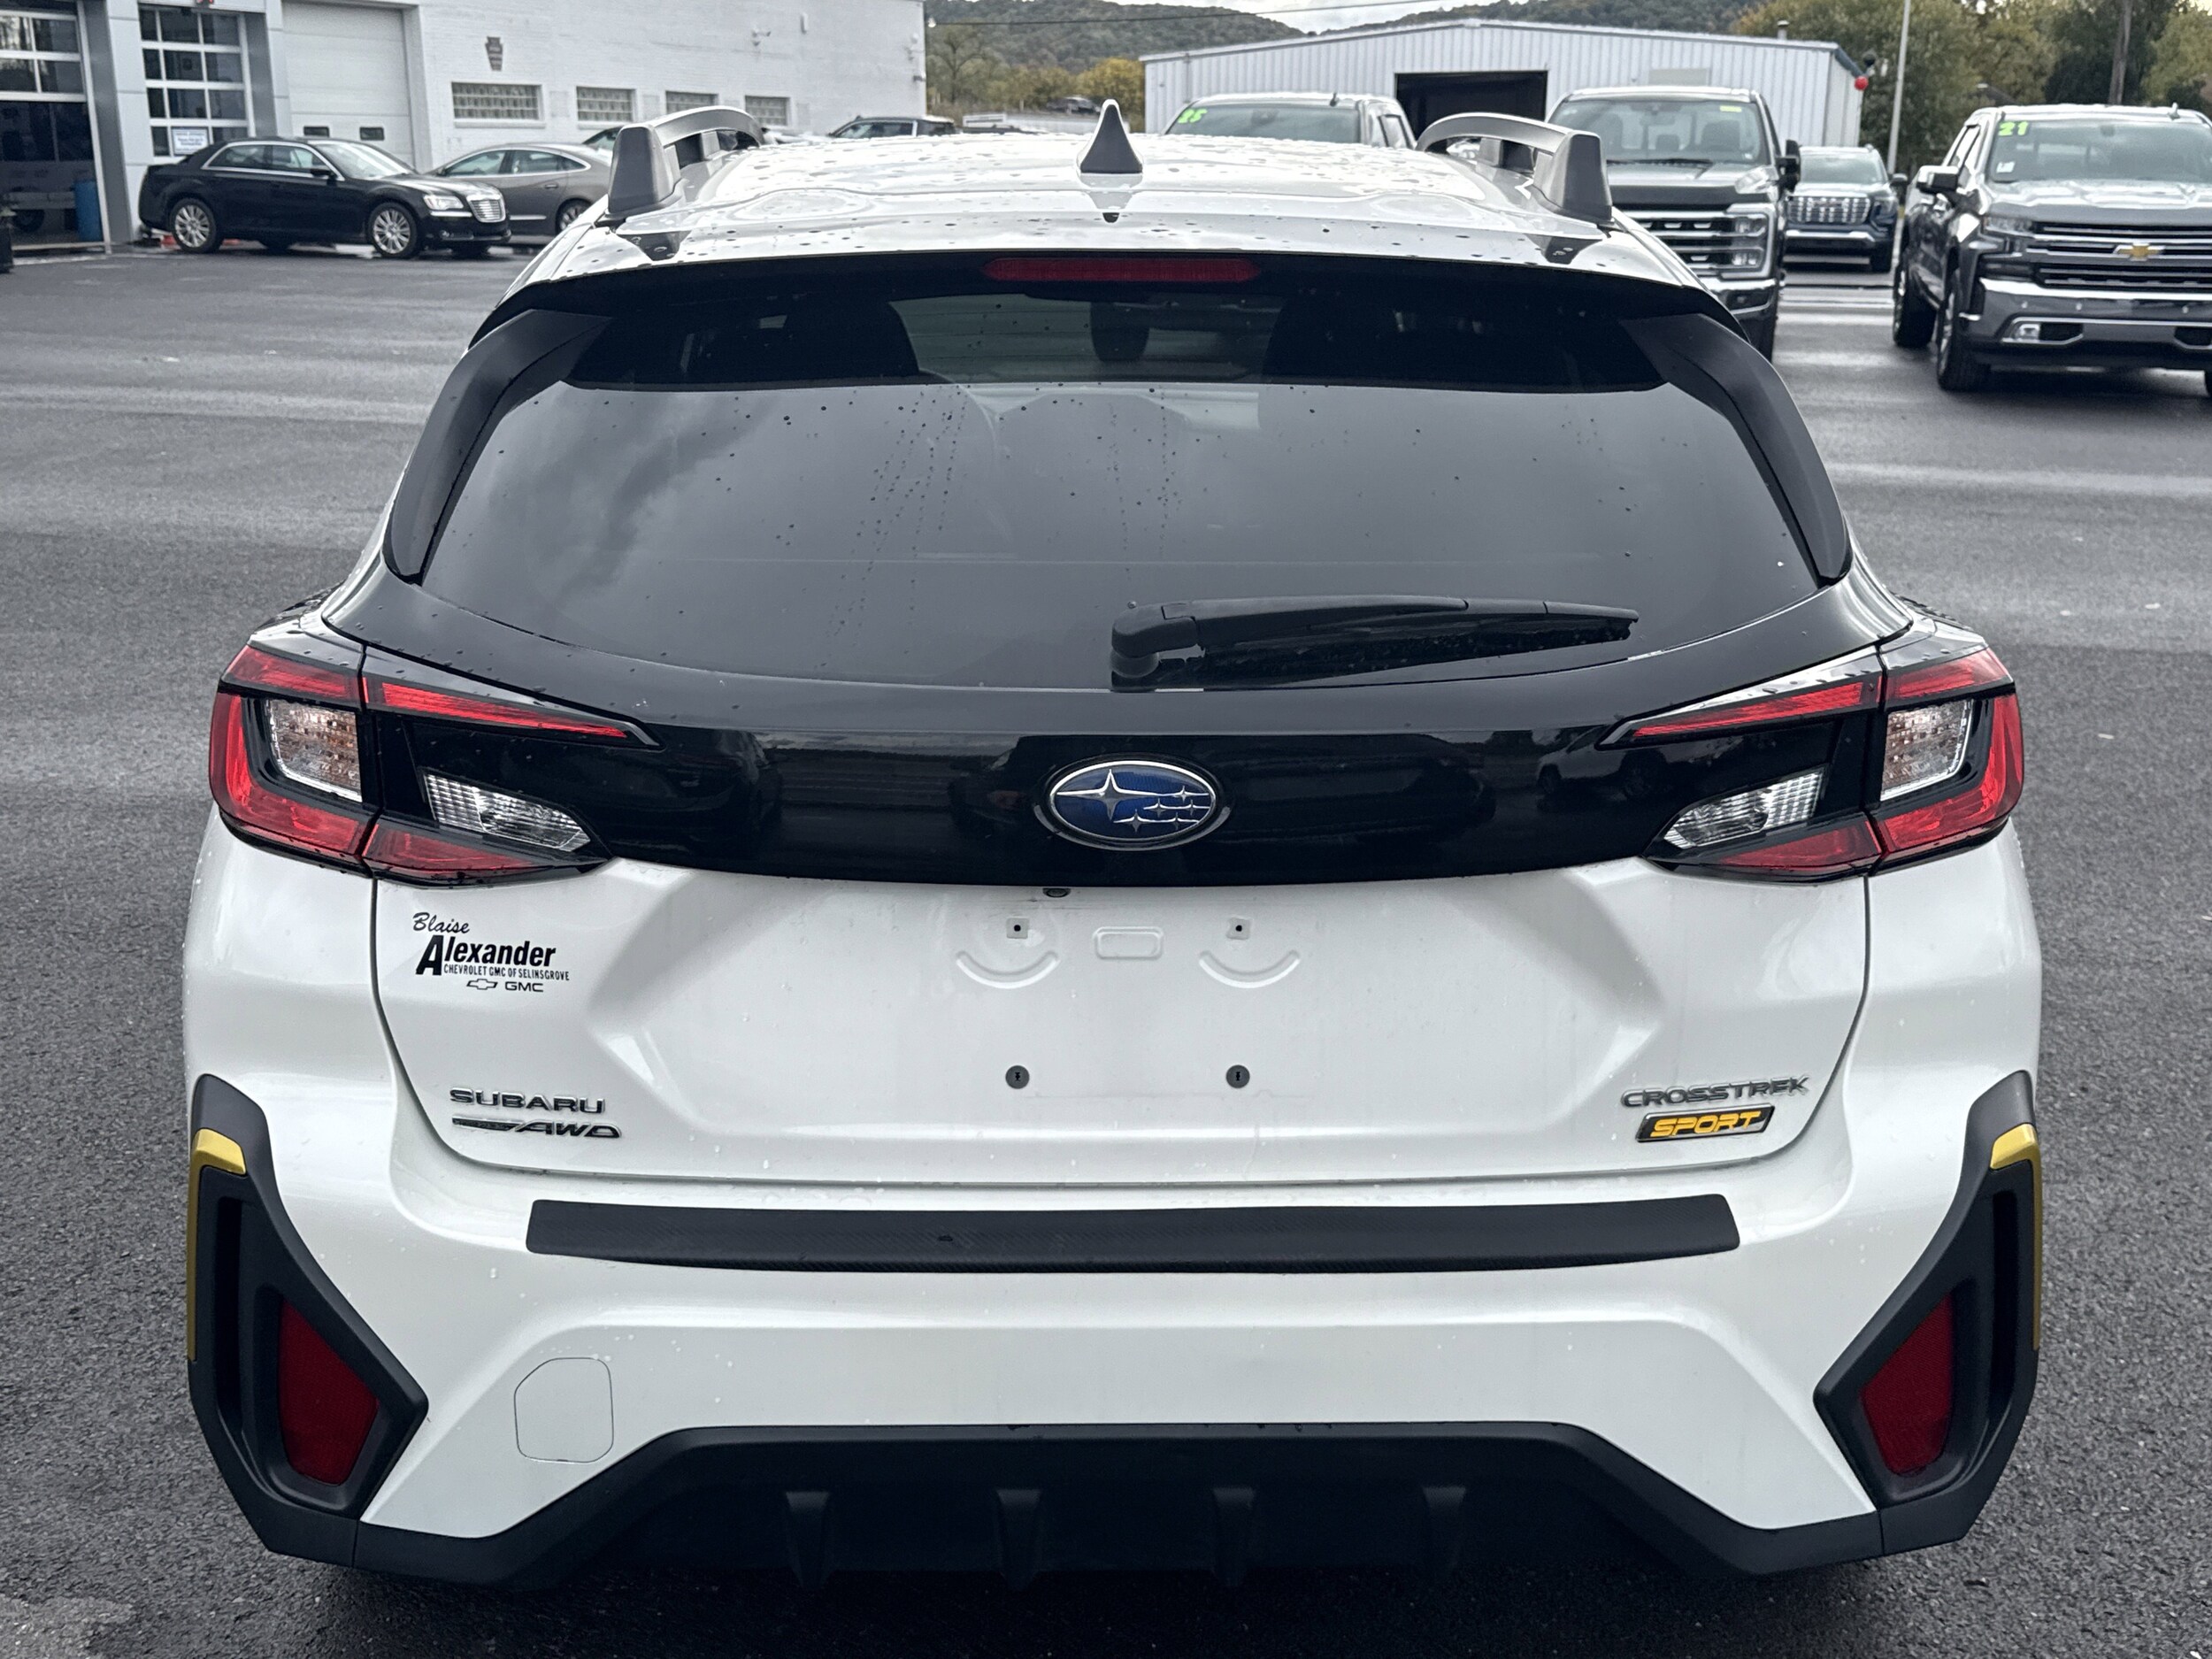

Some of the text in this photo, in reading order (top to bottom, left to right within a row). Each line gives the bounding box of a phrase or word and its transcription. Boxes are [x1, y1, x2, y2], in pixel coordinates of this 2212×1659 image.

[1178, 108, 1208, 124] 25
[1998, 120, 2029, 136] 21
[412, 911, 471, 933] Blaise
[415, 934, 557, 976] Alexander
[443, 964, 570, 981] CHEVROLET GMC OF SELINSGROVE
[505, 981, 544, 992] GMC
[449, 1087, 605, 1114] SUBARU
[1621, 1074, 1810, 1107] CROSSTREK
[515, 1118, 622, 1139] AWD
[1650, 1110, 1762, 1138] SPORT
